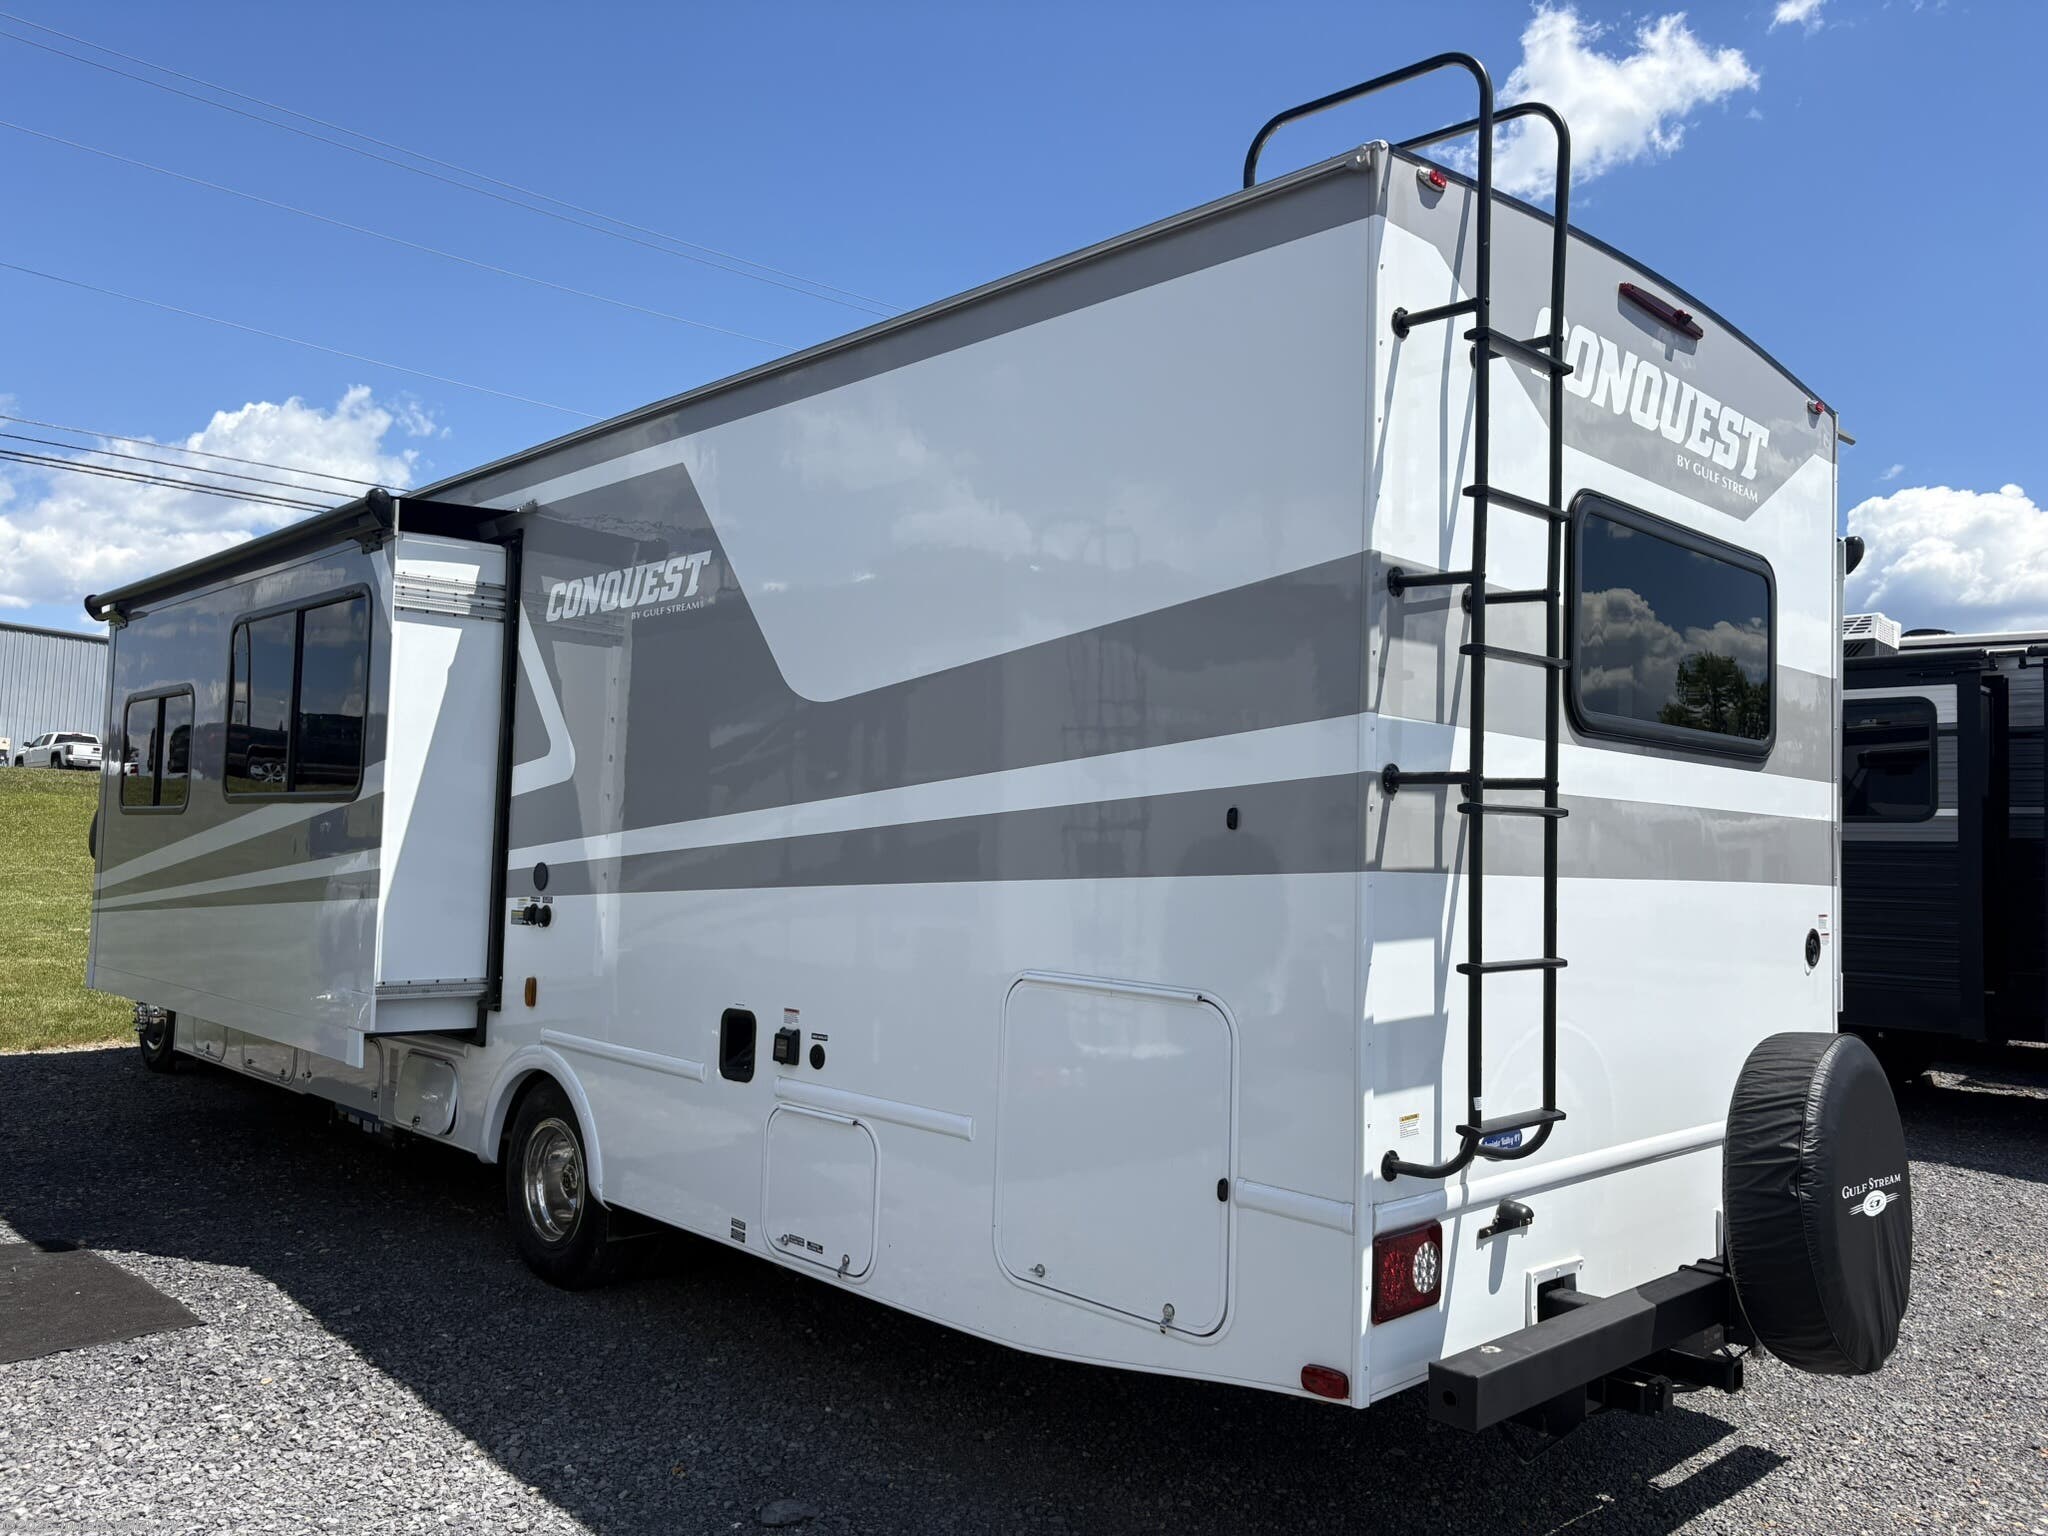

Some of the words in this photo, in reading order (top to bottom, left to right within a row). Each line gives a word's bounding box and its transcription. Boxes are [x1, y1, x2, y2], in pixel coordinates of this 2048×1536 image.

[1677, 454, 1690, 470] BY
[1693, 462, 1719, 484] GULF
[1722, 476, 1758, 503] STREAM
[546, 550, 712, 622] CONQUEST
[631, 610, 641, 620] BY
[643, 606, 664, 618] GULF
[666, 600, 701, 614] STREAM
